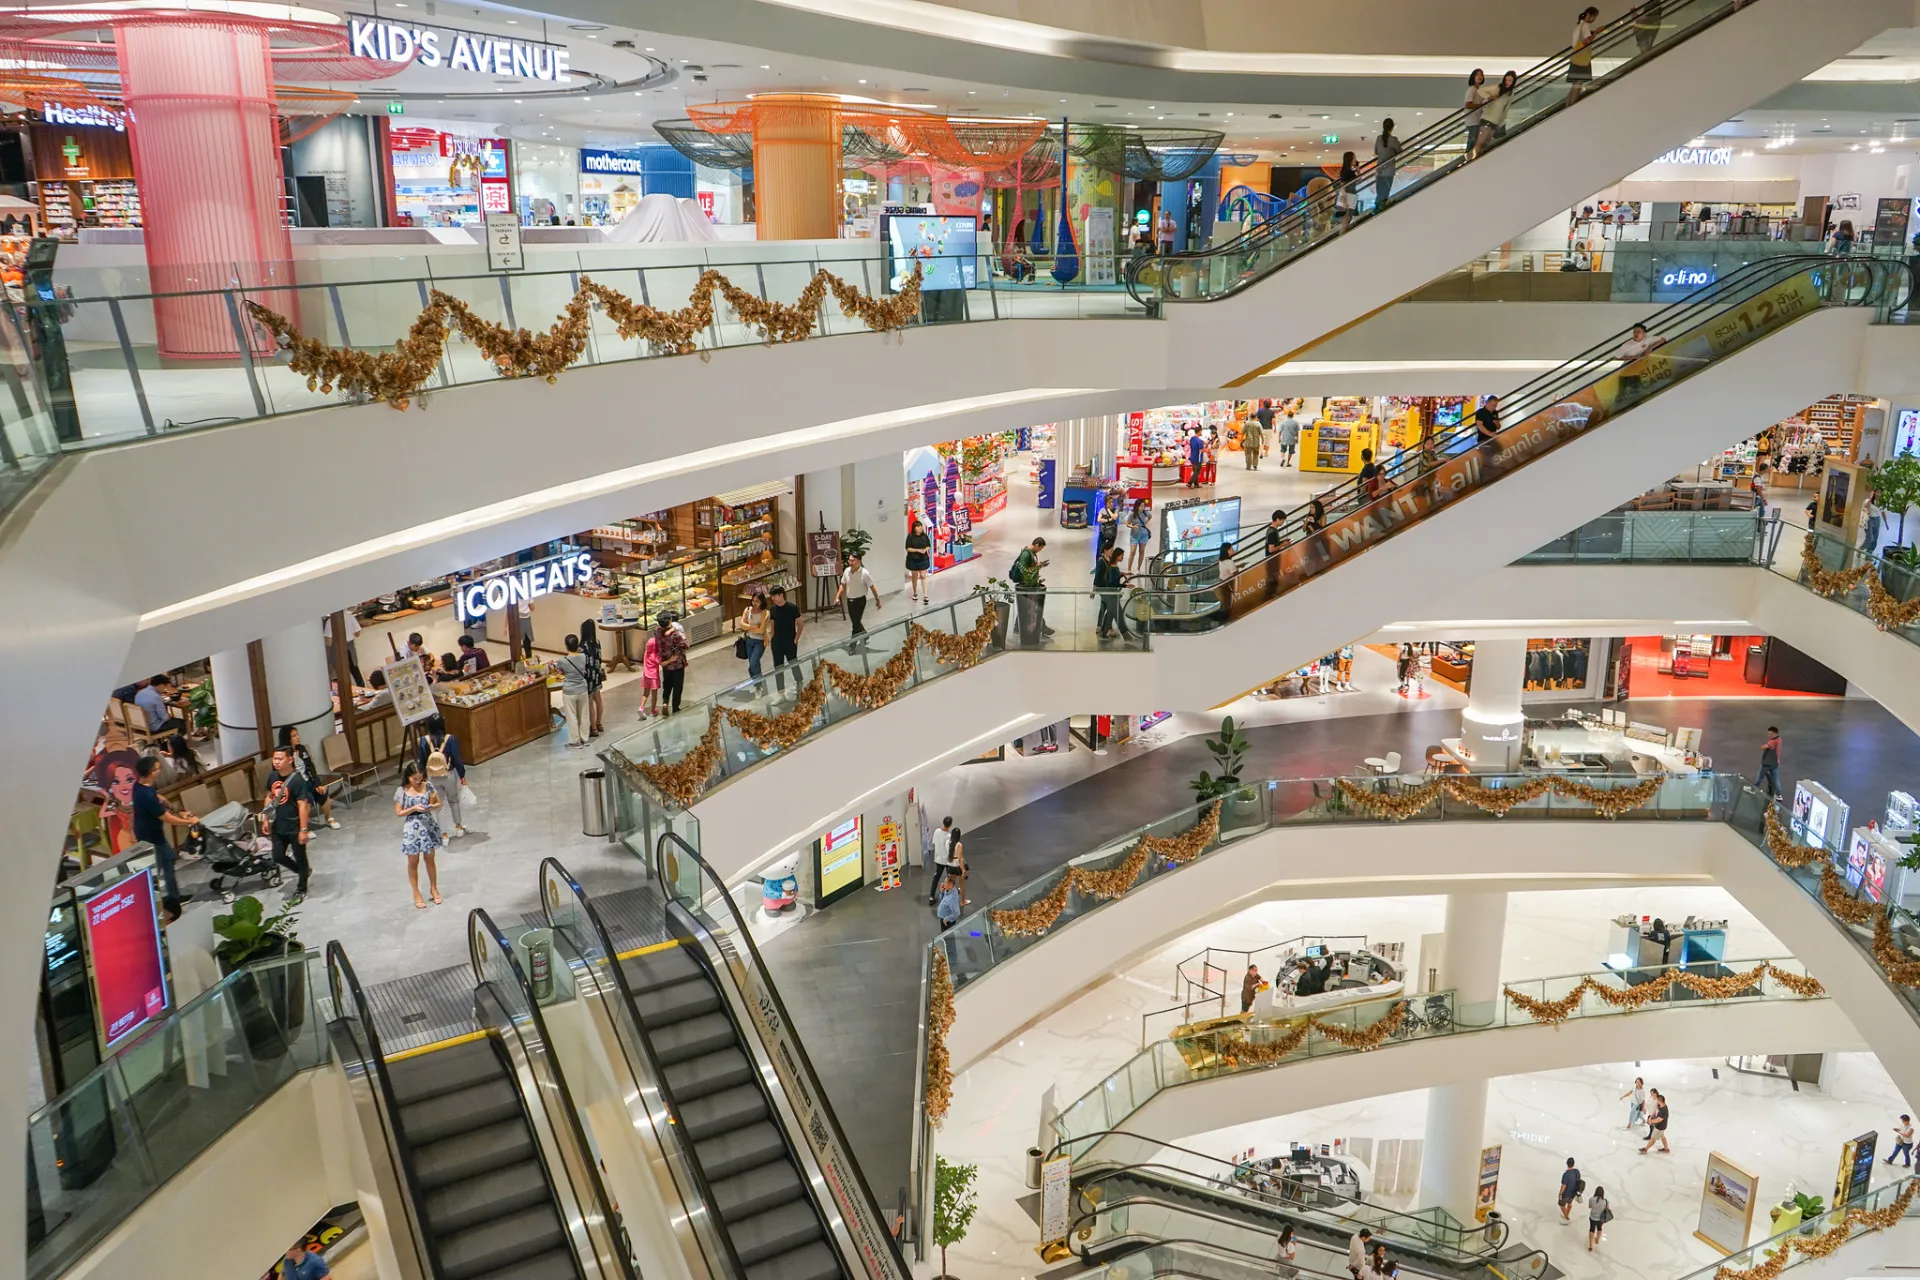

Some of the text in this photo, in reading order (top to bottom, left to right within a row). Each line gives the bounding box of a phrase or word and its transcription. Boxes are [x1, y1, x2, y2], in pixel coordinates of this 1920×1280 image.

[348, 20, 571, 82] KID'S AVENUE
[392, 153, 441, 166] ARMACY
[586, 154, 641, 173] mothercare
[1655, 148, 1732, 165] DUCATION
[1641, 359, 1669, 378] SIAM
[1130, 418, 1140, 452] SALE
[1330, 493, 1419, 552] WANT
[1450, 457, 1481, 491] all
[454, 552, 593, 622] ICONEATS
